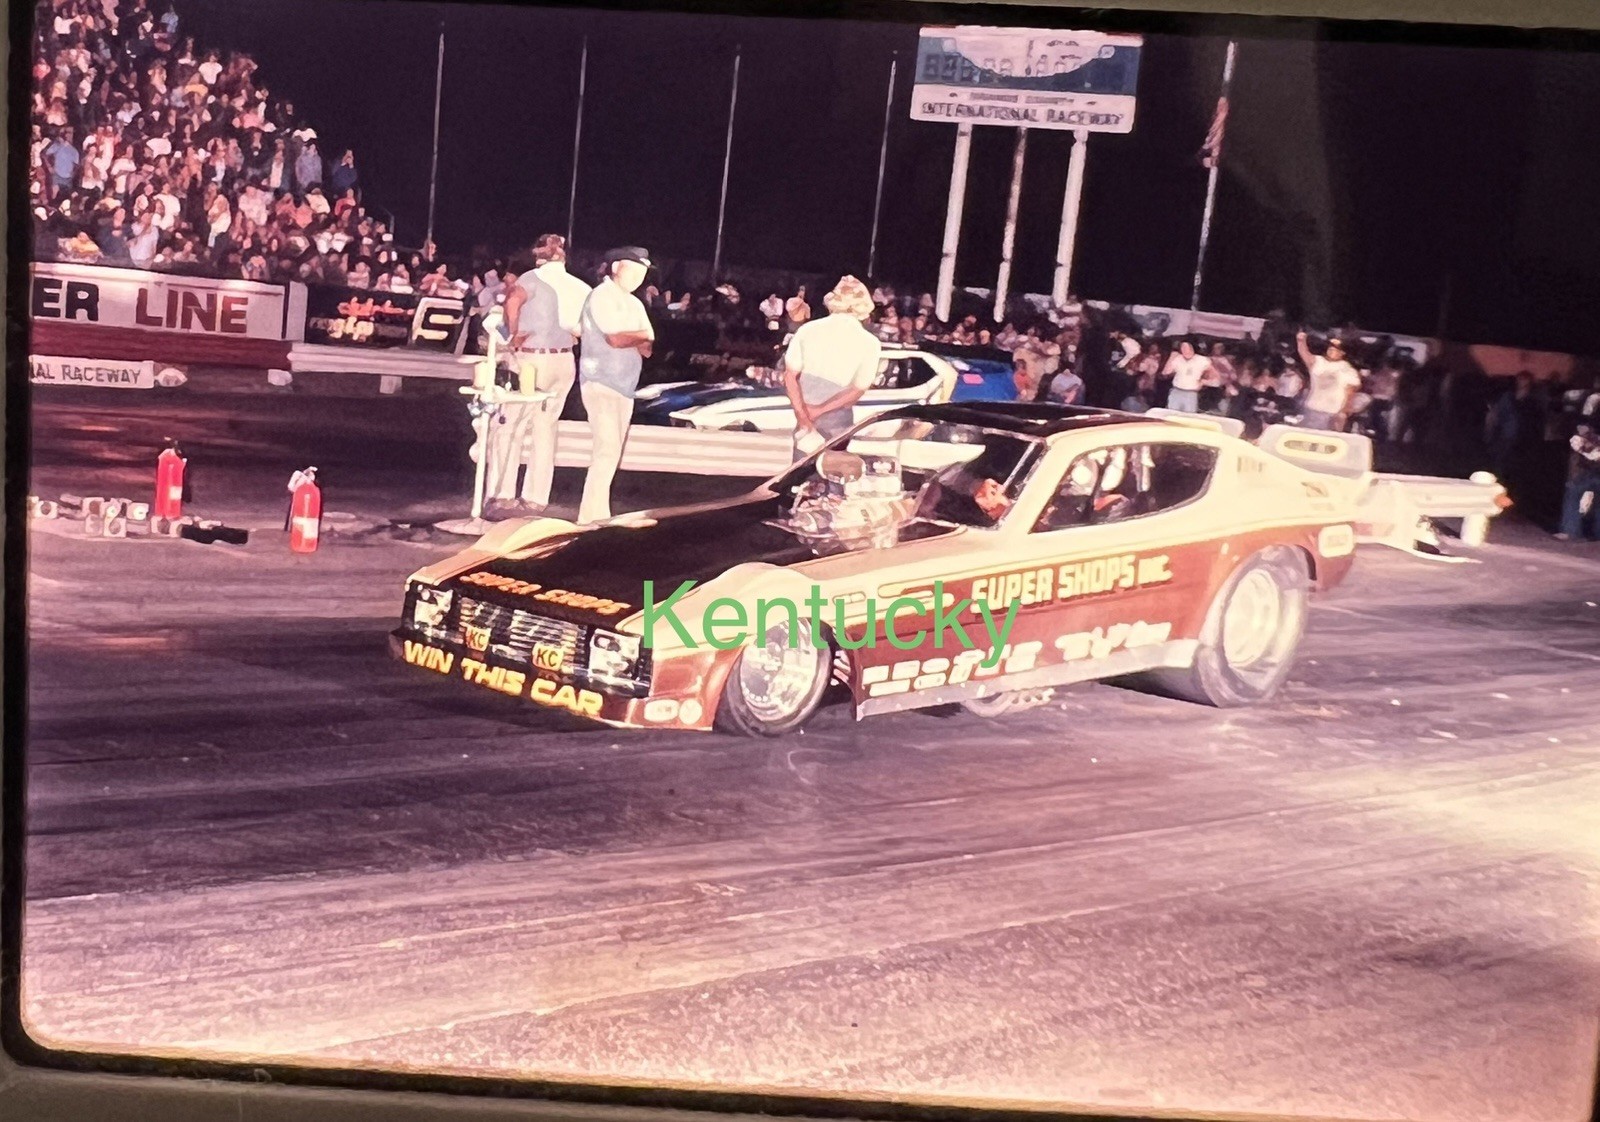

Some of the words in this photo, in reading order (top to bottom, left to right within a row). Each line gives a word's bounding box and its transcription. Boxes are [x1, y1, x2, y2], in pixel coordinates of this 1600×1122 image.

[33, 277, 98, 322] ER
[136, 287, 248, 332] LINE
[61, 364, 141, 384] RACEWAY
[970, 568, 1054, 614] SUPER
[1057, 555, 1136, 598] SHOPS
[403, 640, 454, 674] WIN
[461, 657, 526, 696] THIS
[530, 678, 604, 715] CAR
[536, 649, 560, 668] KC
